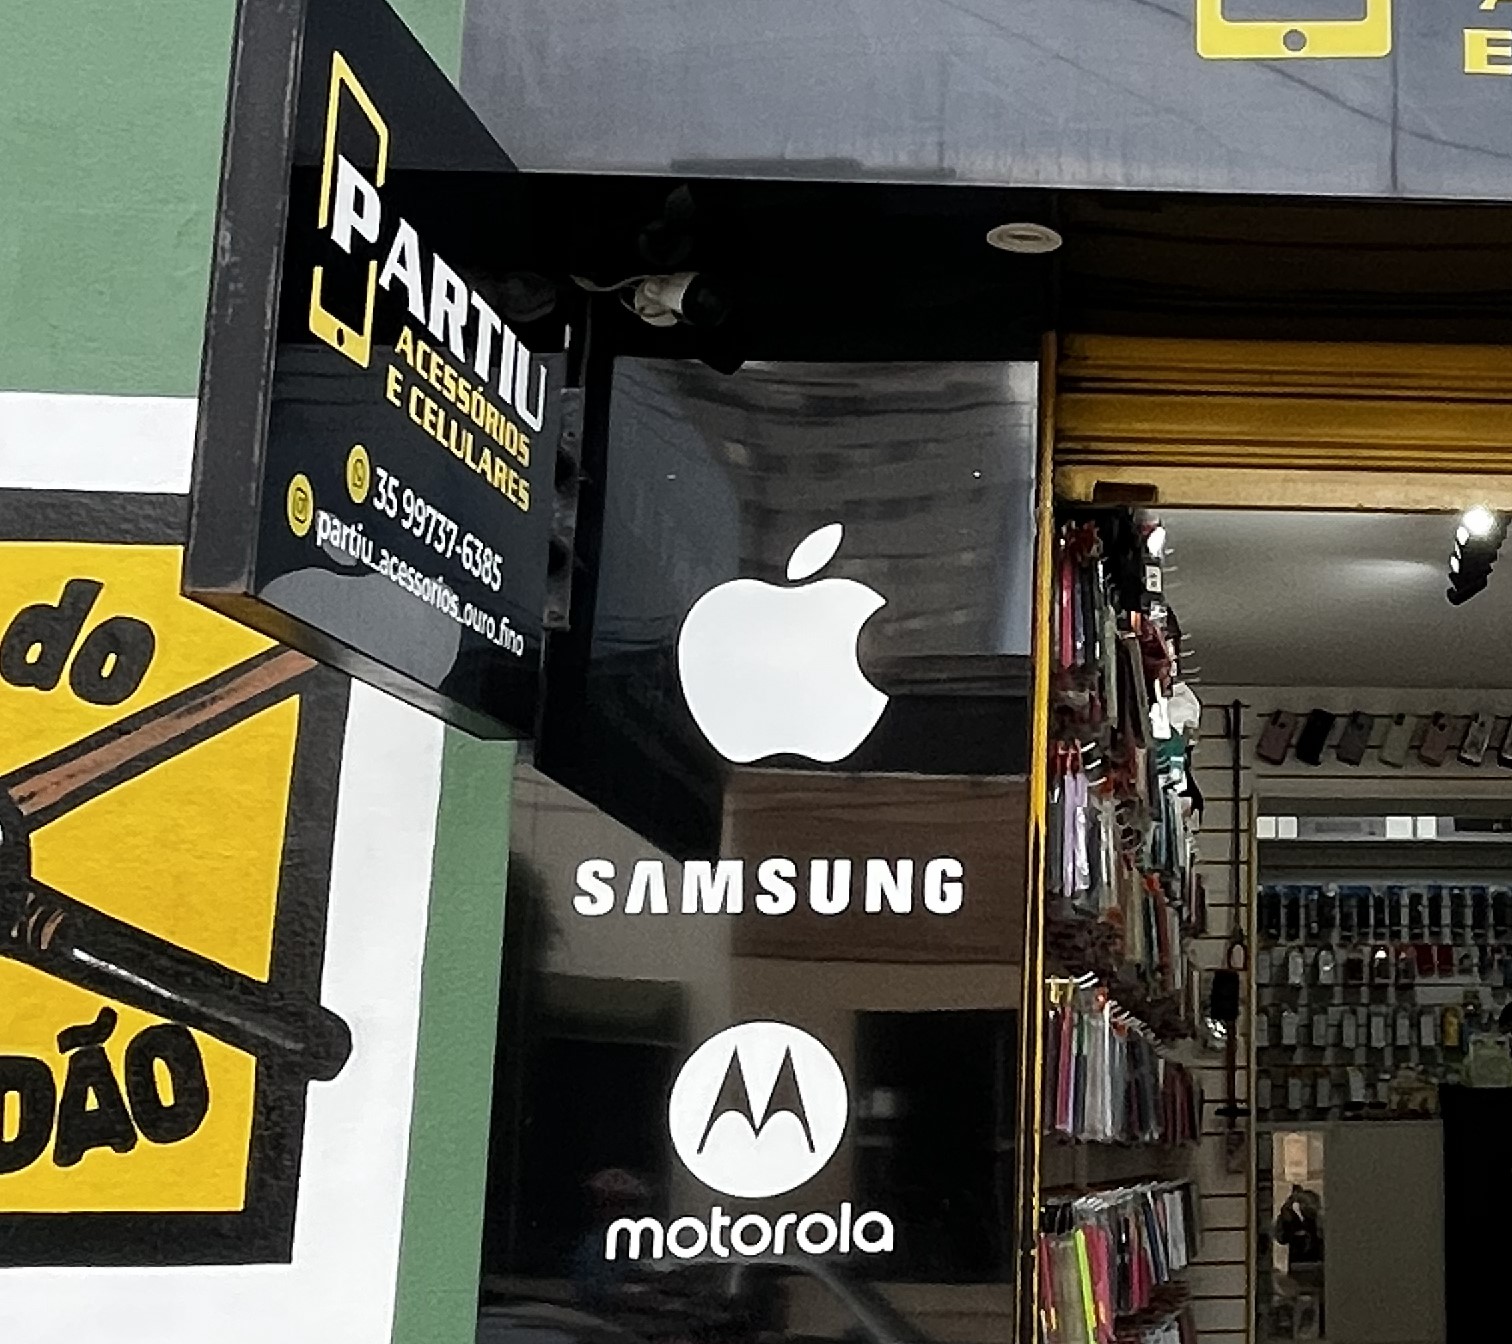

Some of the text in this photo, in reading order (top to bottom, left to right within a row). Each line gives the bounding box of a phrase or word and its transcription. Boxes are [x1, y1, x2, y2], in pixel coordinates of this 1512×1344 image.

[330, 153, 548, 433] PARTIU
[385, 363, 532, 514] E CELULARES
[394, 324, 532, 469] ACESSÓRIOS
[315, 508, 525, 657] partiu_acessorios_ouro_fino
[372, 466, 504, 593] 35 99737-6385
[0, 577, 158, 707] do
[572, 856, 966, 918] SAMSUNG
[0, 1005, 211, 1176] DÃO
[605, 1202, 895, 1260] motorola
